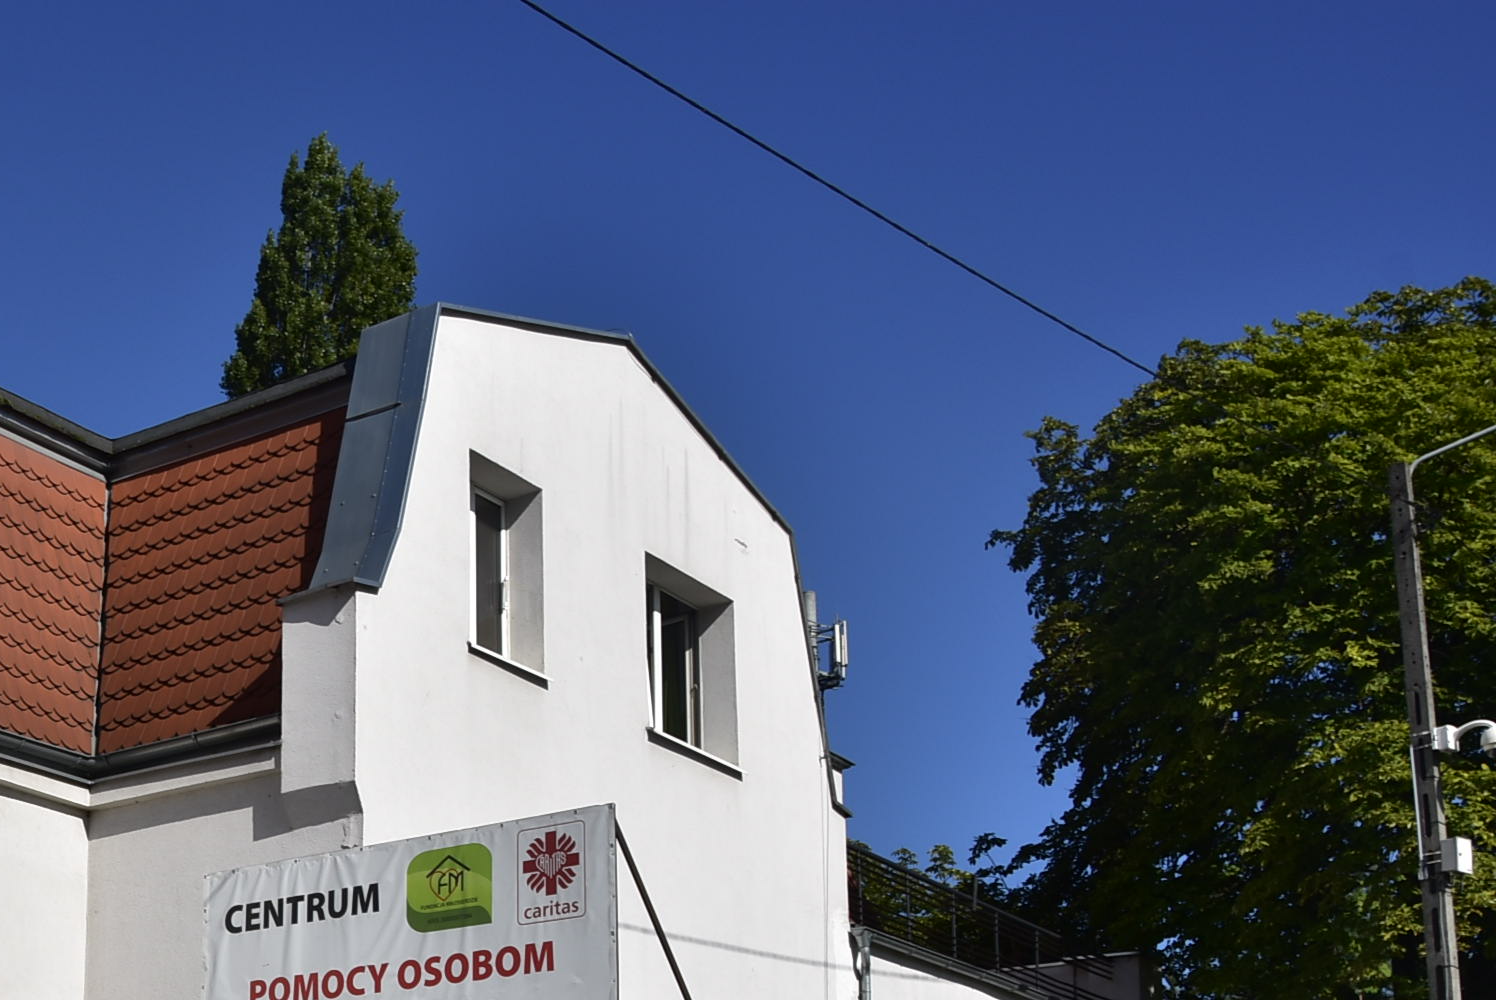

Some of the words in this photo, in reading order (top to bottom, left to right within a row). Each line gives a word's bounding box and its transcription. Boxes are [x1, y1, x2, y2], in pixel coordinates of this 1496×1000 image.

[225, 882, 381, 934] CENTRUM
[524, 901, 580, 920] caritas
[396, 940, 556, 989] OSOBOM
